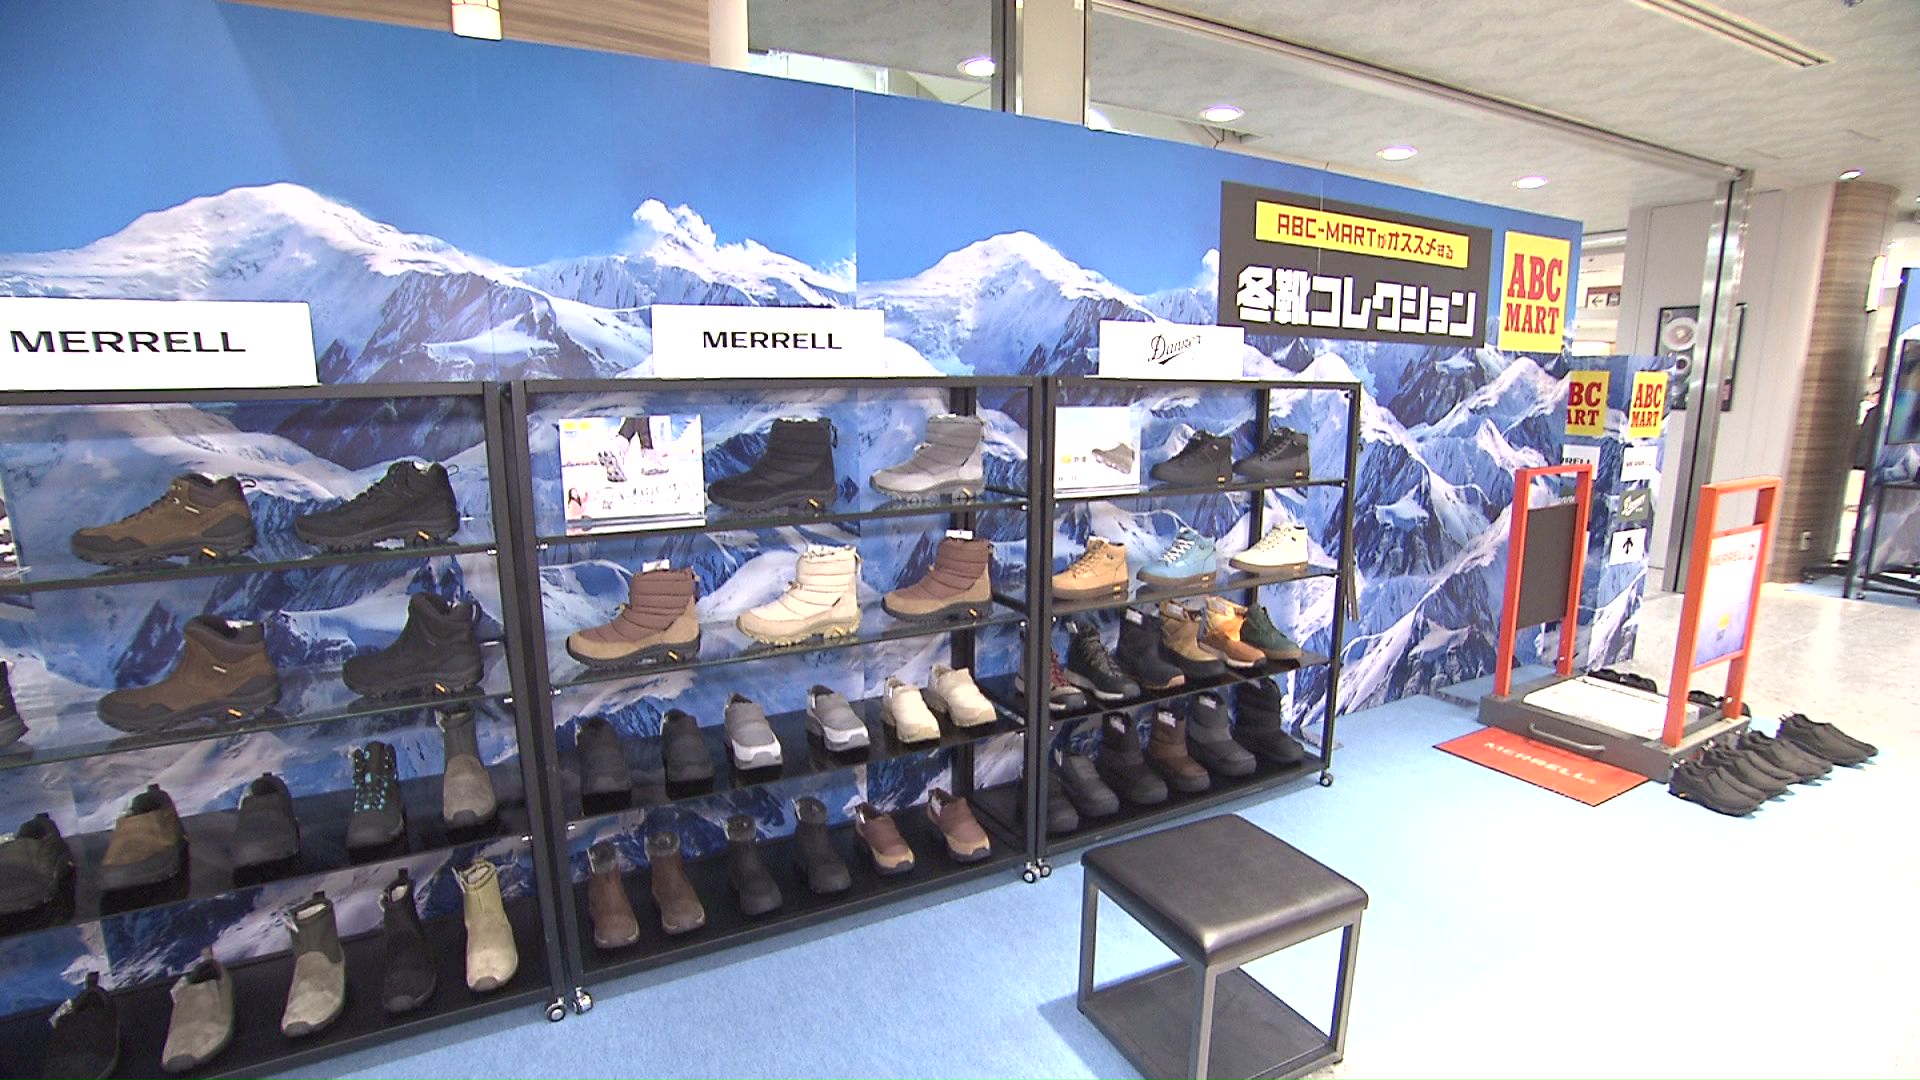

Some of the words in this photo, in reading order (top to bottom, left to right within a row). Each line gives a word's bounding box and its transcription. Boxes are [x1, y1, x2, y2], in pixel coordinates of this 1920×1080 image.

[1507, 253, 1563, 303] ABC
[1504, 302, 1560, 335] MART
[9, 330, 247, 353] MERRELL
[703, 331, 843, 350] MERRELL
[1568, 382, 1602, 407] BC
[1633, 383, 1663, 409] ABC
[1567, 409, 1600, 426] ART
[1631, 411, 1660, 428] MART
